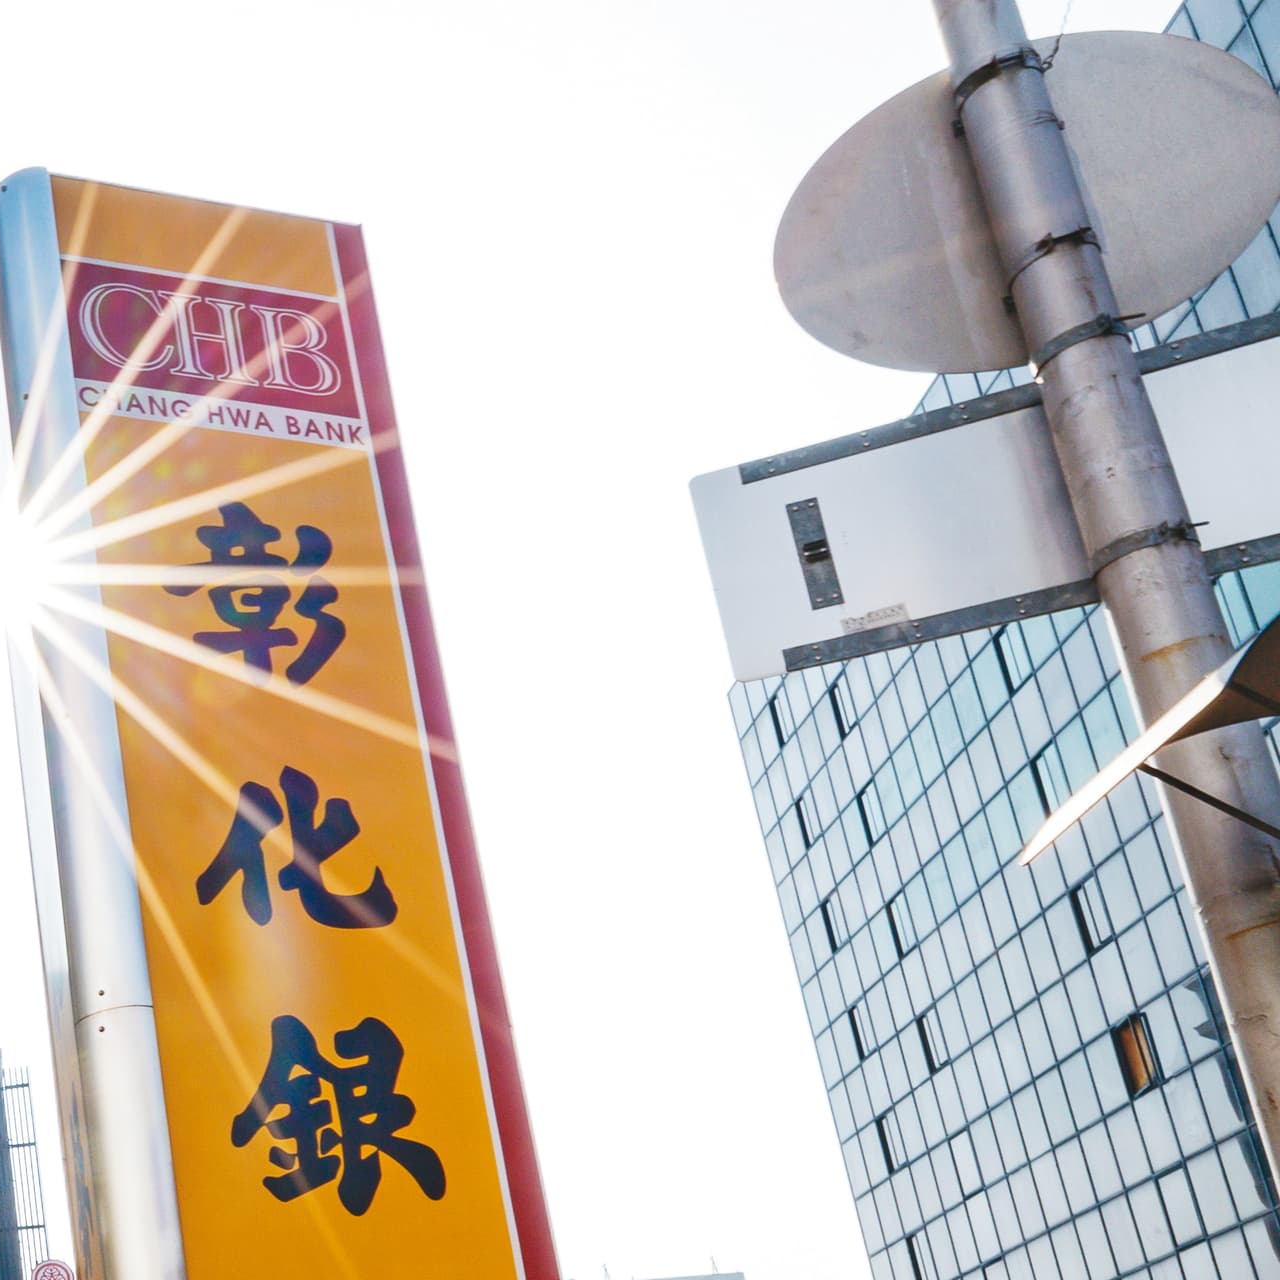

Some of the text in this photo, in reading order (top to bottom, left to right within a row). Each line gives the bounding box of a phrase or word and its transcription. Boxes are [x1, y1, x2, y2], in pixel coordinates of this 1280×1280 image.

[79, 282, 341, 396] CHB
[208, 404, 274, 433] HWA
[286, 415, 366, 446] BANK
